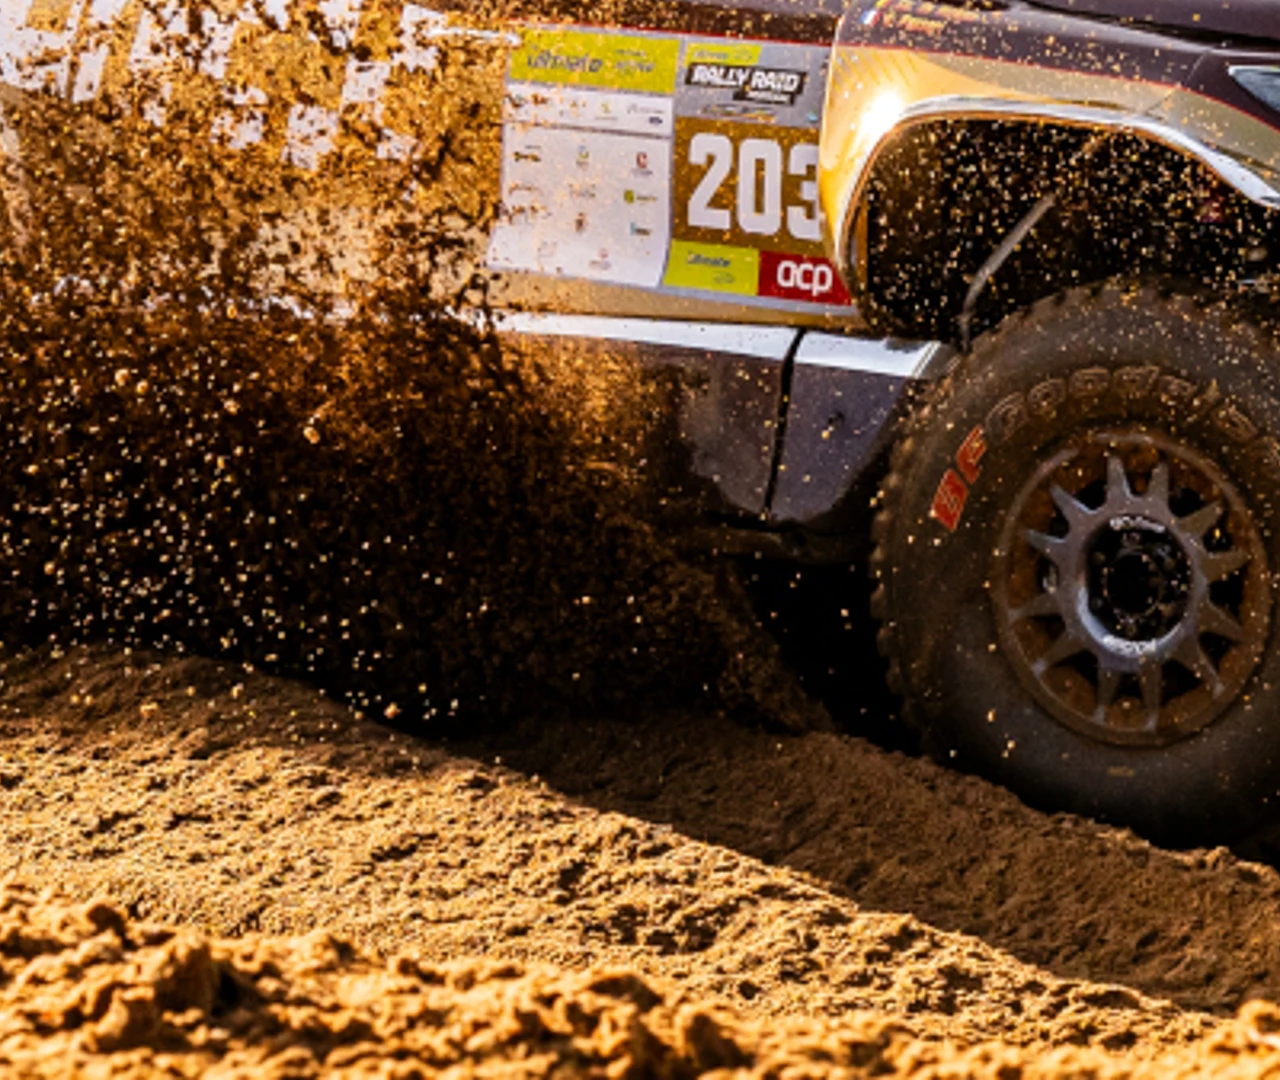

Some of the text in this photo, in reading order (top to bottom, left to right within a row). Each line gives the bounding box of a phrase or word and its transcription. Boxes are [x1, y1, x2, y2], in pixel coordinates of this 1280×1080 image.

[692, 64, 799, 92] RALLY RAID
[688, 133, 822, 241] 203
[776, 260, 833, 297] acp
